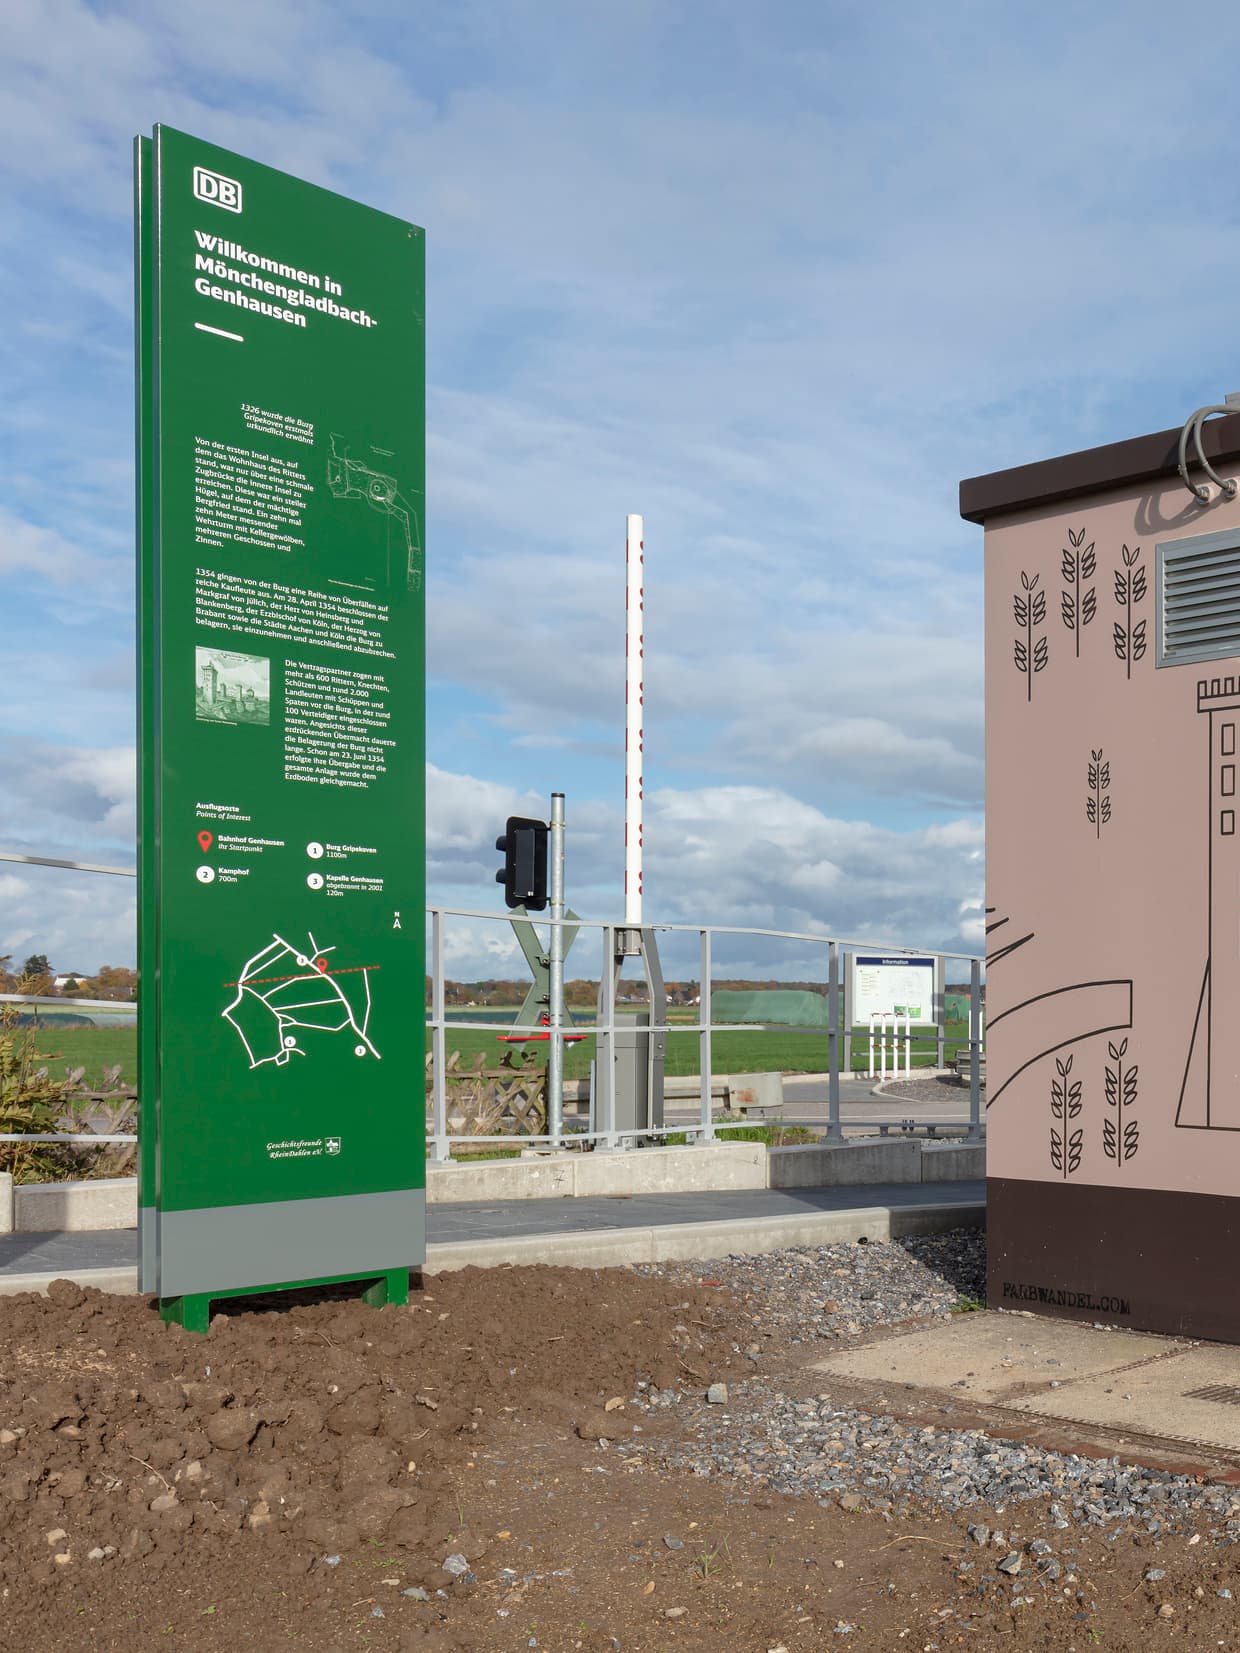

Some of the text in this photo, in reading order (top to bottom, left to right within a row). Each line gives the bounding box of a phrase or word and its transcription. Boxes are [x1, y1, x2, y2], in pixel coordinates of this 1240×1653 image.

[194, 230, 342, 296] Willkommen in
[195, 254, 378, 328] Mönchengladbach-
[194, 278, 307, 328] Genhausen
[240, 403, 259, 414] 1326
[261, 410, 283, 420] wurde
[296, 419, 313, 430] Burg
[244, 412, 313, 436] Gripekoven erstmals
[246, 422, 313, 444] urkundlich erwähnt
[195, 436, 210, 446] Von
[211, 441, 224, 450] der
[226, 446, 249, 456] ersten
[251, 450, 268, 461] Insel
[195, 447, 305, 480] dem das Wohnhaus des Ritters
[195, 466, 234, 481] Zugbrücke
[249, 479, 272, 490] innere
[274, 485, 291, 495] Insel
[250, 470, 267, 480] über
[268, 475, 284, 484] eine
[285, 480, 313, 491] schmale
[234, 485, 255, 496] Diese
[284, 498, 306, 508] steiler
[234, 495, 251, 504] dem
[252, 500, 265, 508] der
[266, 504, 298, 516] mächtige
[195, 506, 277, 530] zehn Meter messender
[195, 515, 233, 529] Wehrturm
[195, 526, 231, 538] mehreren
[233, 533, 275, 548] Geschossen
[196, 568, 215, 577] 1354
[217, 573, 241, 582] gingen
[272, 583, 289, 593] Burg
[308, 590, 327, 600] Reihe
[342, 596, 376, 609] Überfällen
[196, 579, 219, 588] reiche
[221, 582, 255, 595] Kaufleute
[300, 598, 316, 606] April
[319, 601, 336, 610] 1354
[337, 605, 376, 618] beschlossen
[195, 587, 229, 599] Markgraf
[284, 604, 300, 613] Herr
[316, 610, 349, 624] Heinsberg
[260, 609, 296, 621] Erzbischof
[344, 625, 367, 636] Herzog
[244, 626, 292, 640] einzunehmen
[308, 638, 352, 650] anschließend
[298, 661, 351, 676] Vertragspartner
[352, 672, 372, 680] zogen
[285, 678, 316, 689] Schützen
[300, 709, 337, 720] Verteidiger
[339, 715, 386, 727] eingeschlossen
[284, 726, 396, 746] erdrückenden Übermacht dauerte
[285, 772, 318, 782] Erdboden
[196, 802, 239, 812] Ausflugsorte
[228, 843, 262, 852] Startpunkt
[248, 837, 284, 845] Genhausen
[342, 845, 376, 853] Gripekoven
[218, 867, 249, 875] Kamphof
